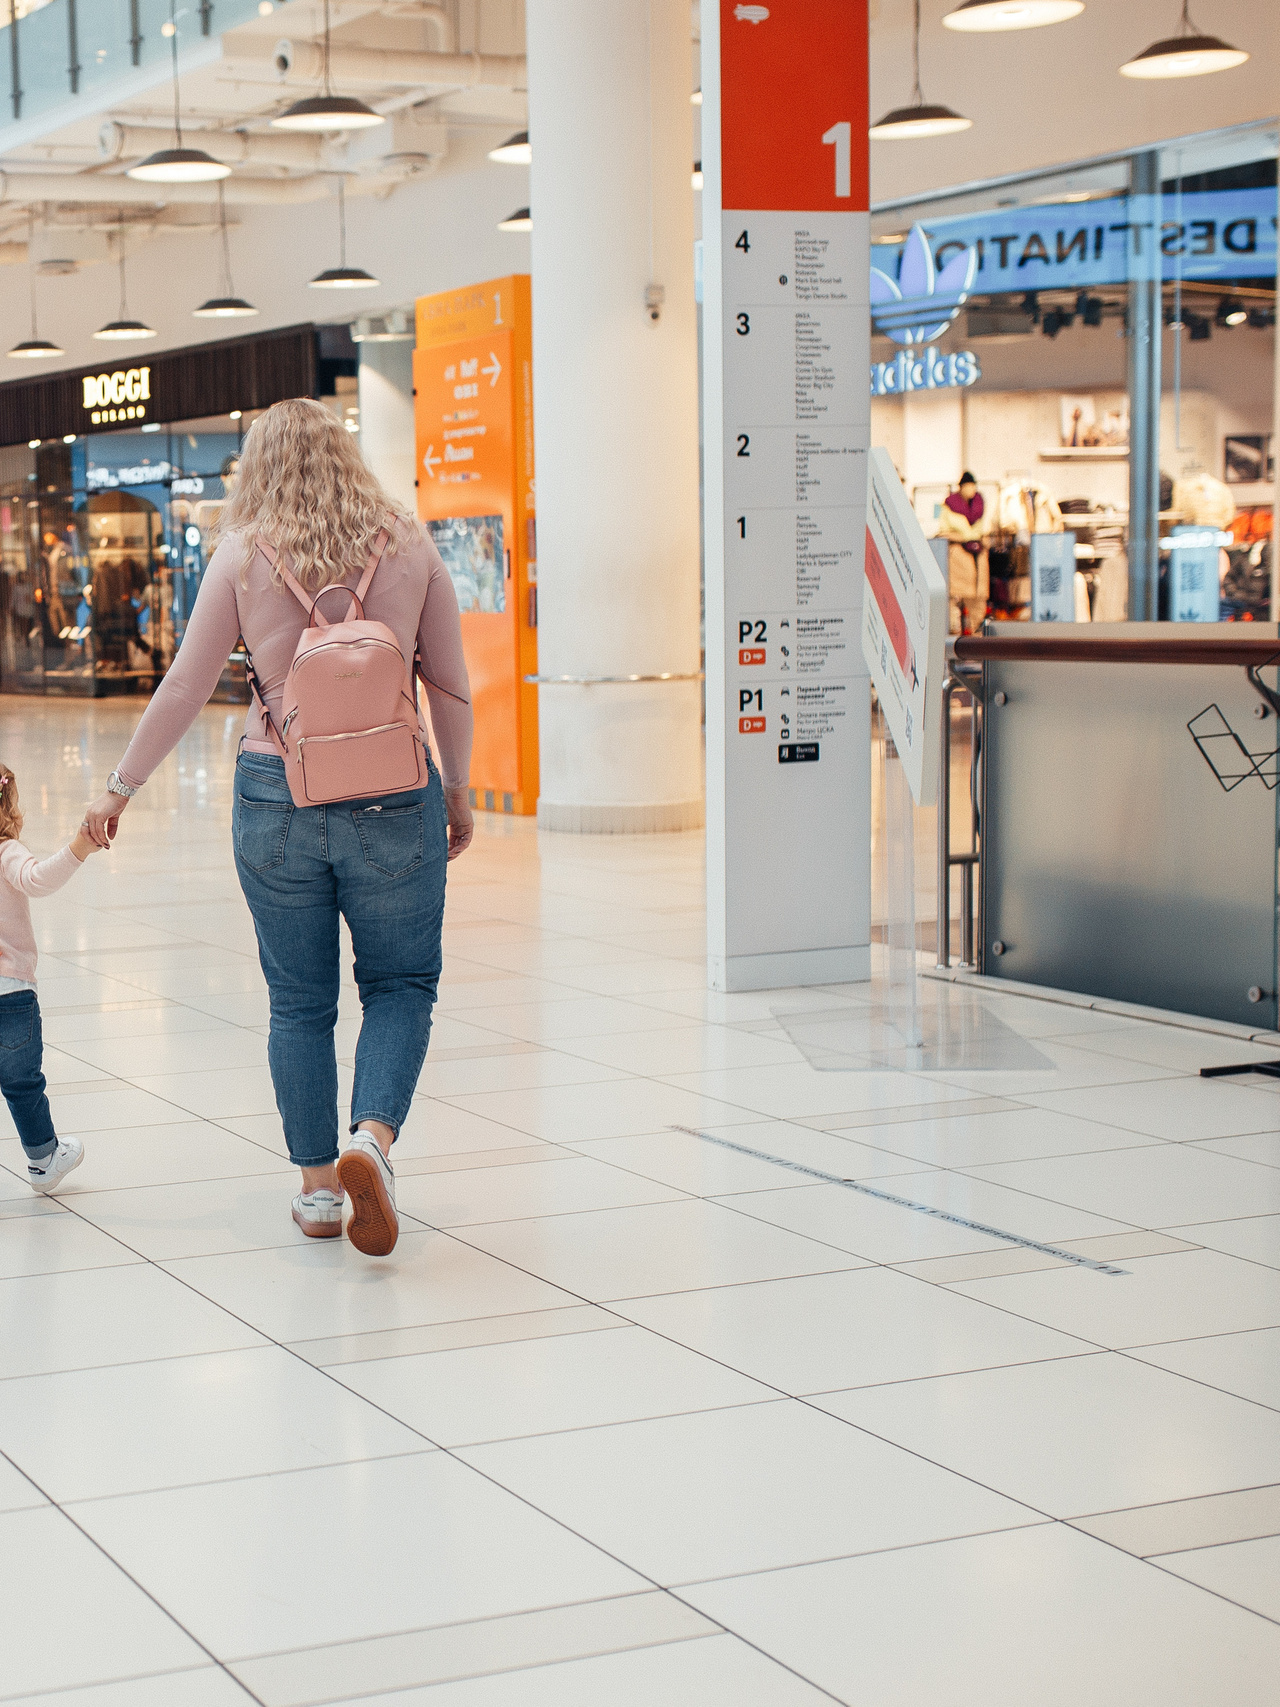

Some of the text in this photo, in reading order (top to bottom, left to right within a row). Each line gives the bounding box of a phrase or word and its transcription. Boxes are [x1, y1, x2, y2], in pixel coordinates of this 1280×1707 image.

[821, 121, 852, 198] 1
[734, 229, 751, 253] 4
[493, 291, 504, 325] 1
[735, 312, 751, 336] 3
[871, 346, 979, 397] adidas
[82, 366, 151, 409] BOGGI
[736, 433, 750, 457] 2
[736, 515, 747, 539] 1
[739, 620, 767, 643] P2
[743, 651, 751, 663] D
[739, 688, 763, 712] P1
[743, 719, 751, 731] D
[796, 746, 816, 754] Выход
